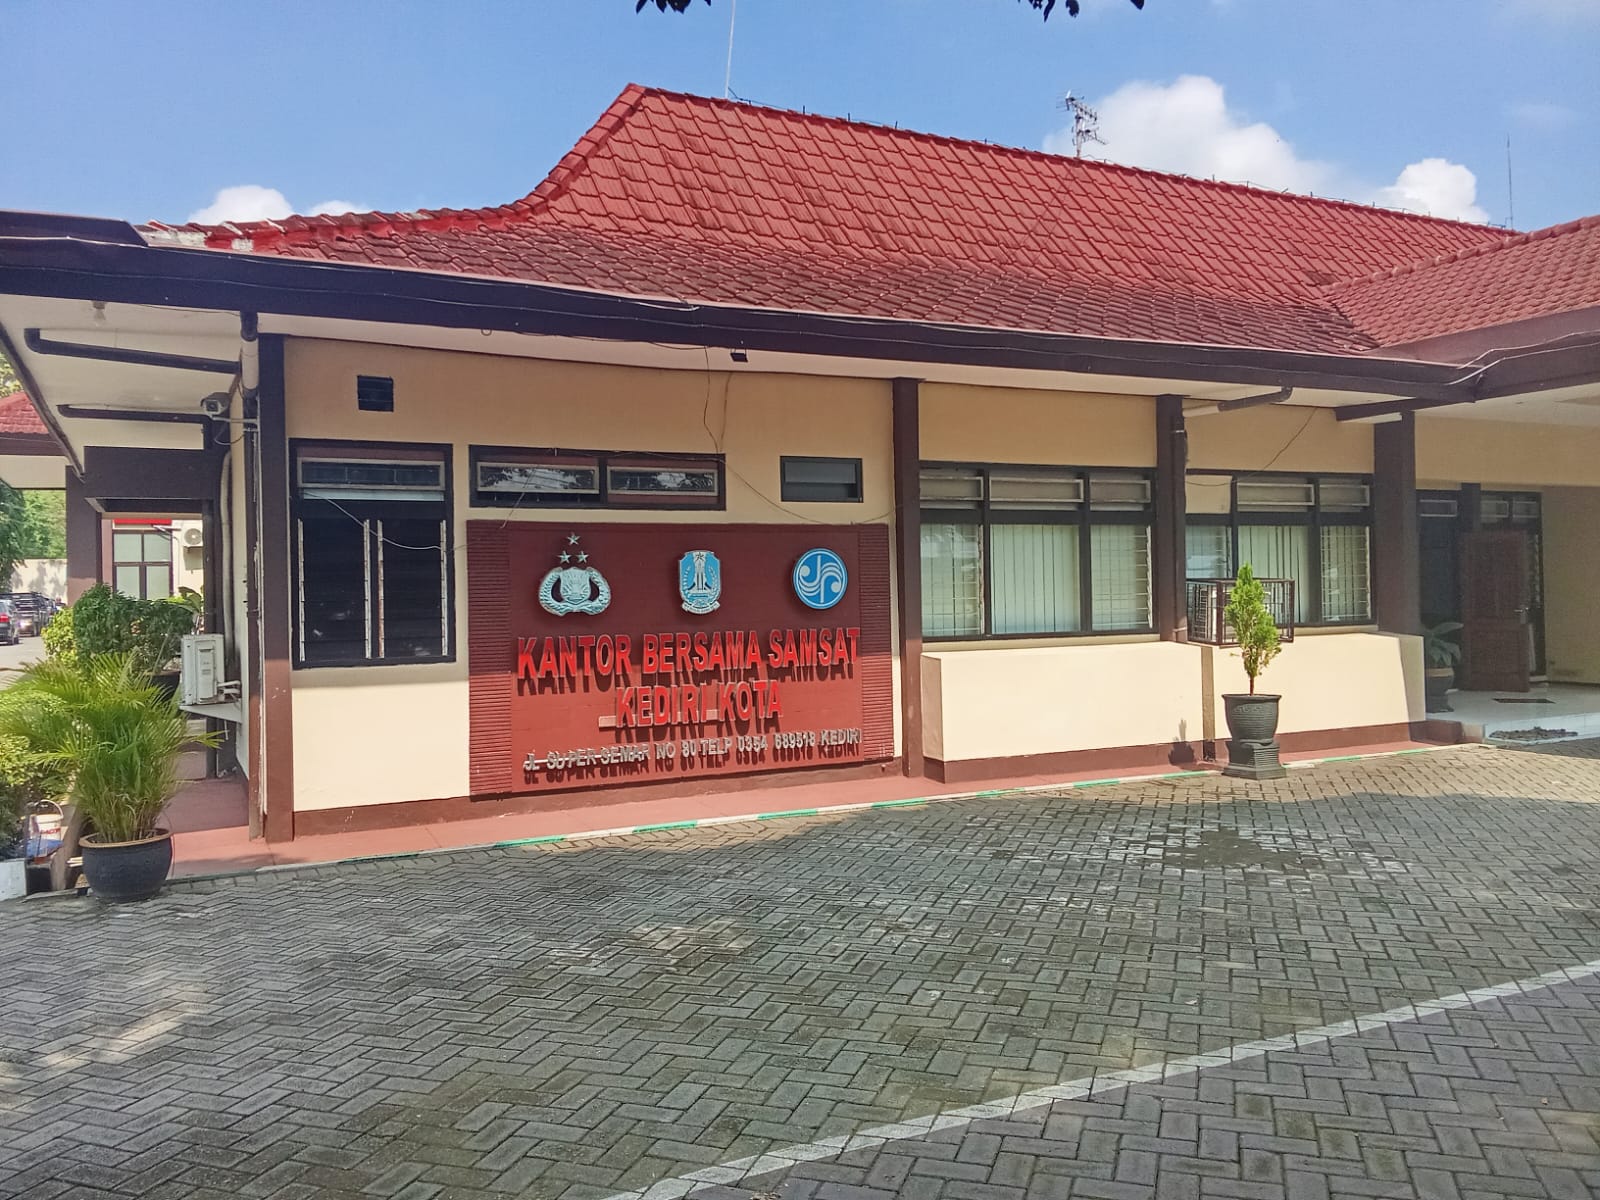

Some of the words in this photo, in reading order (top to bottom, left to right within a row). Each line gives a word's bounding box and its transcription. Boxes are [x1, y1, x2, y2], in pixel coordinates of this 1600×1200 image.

[517, 634, 632, 679] KANTOR
[643, 630, 762, 675] BERSAMA
[768, 627, 860, 668] SAMSAT
[616, 683, 707, 728] KEDIRI
[718, 680, 783, 721] KOTA
[600, 743, 651, 765] SEMAR
[655, 742, 676, 760] NO
[681, 740, 697, 757] 80
[700, 736, 732, 755] TELP
[736, 735, 768, 753] 0354
[821, 728, 862, 746] KEDIRI
